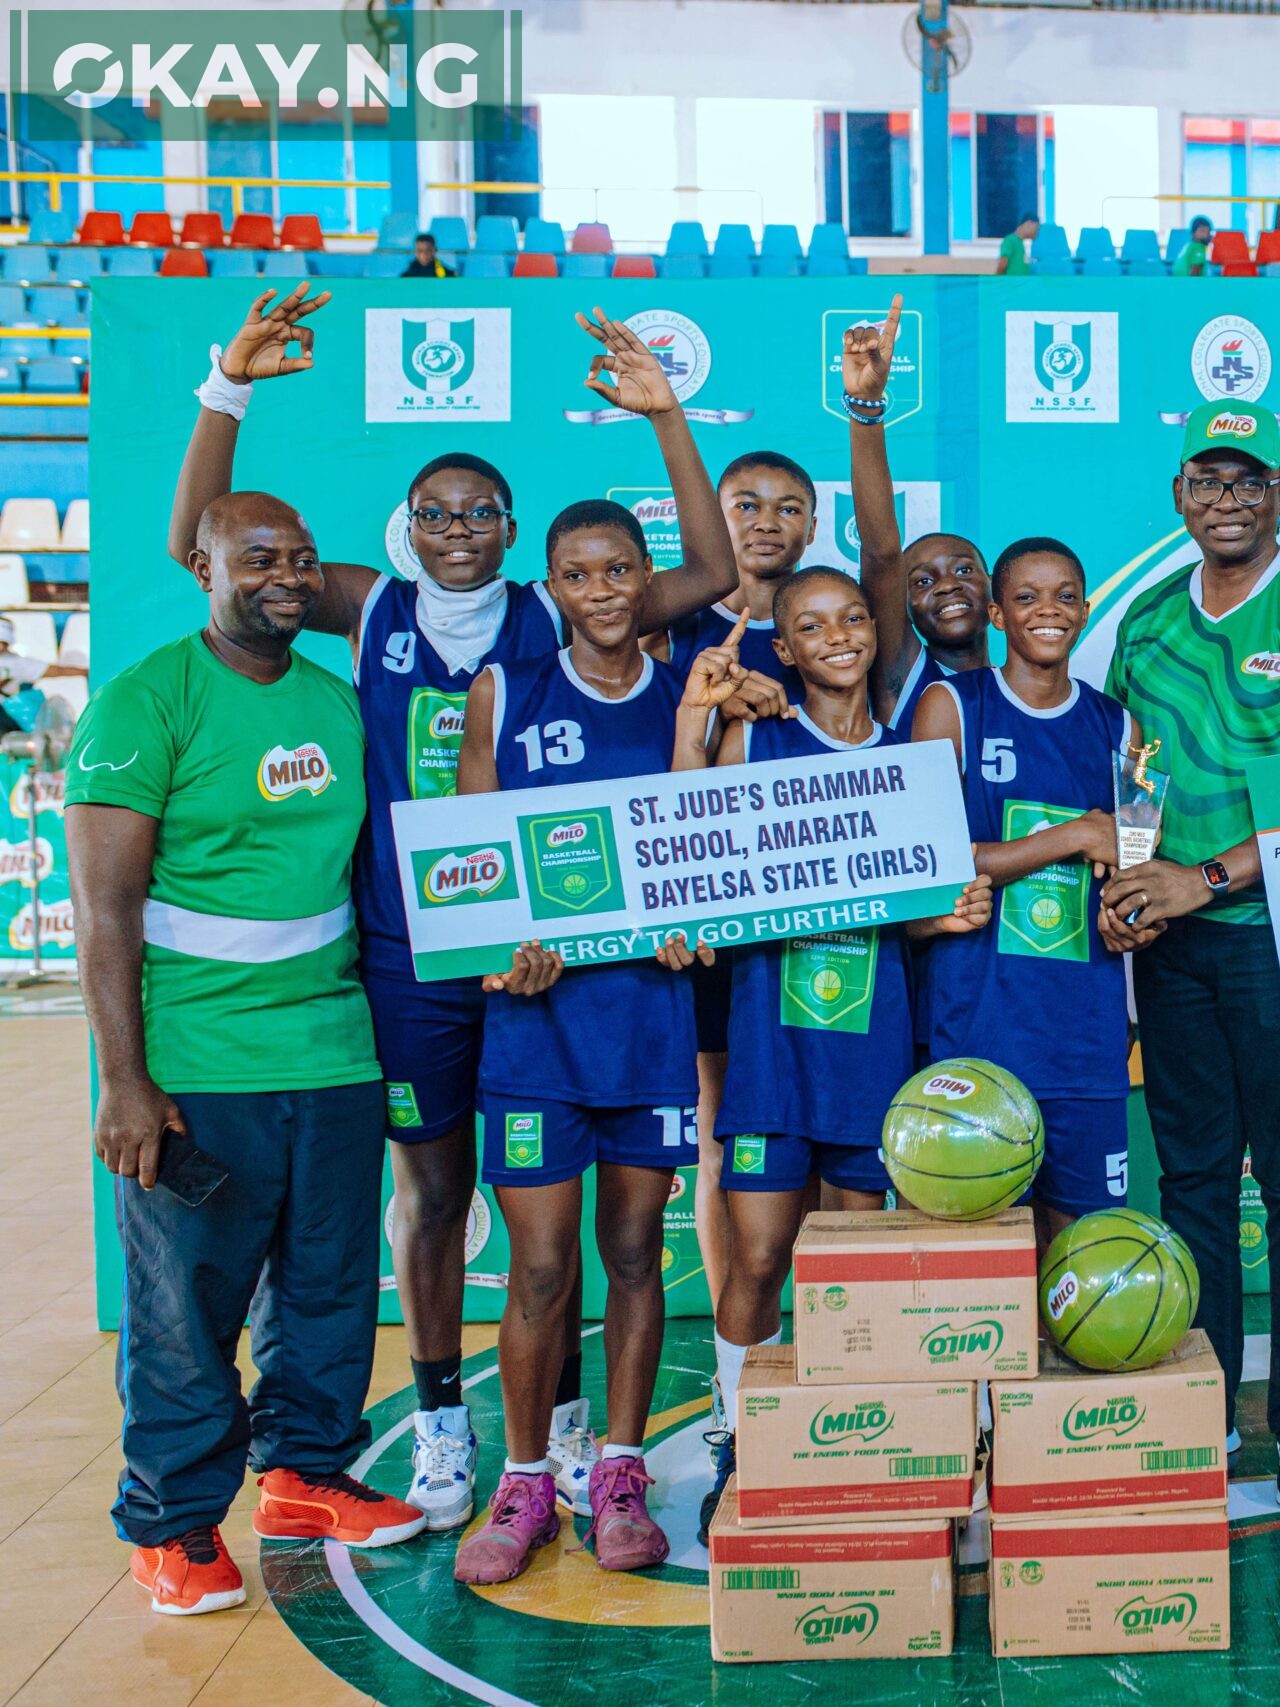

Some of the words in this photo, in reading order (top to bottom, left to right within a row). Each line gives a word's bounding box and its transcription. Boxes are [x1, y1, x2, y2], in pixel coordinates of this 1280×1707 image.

[1213, 419, 1252, 433] MILO
[381, 630, 417, 675] 9
[422, 747, 460, 758] BASKE
[515, 719, 585, 773] 13
[418, 758, 459, 769] CHAMPI
[981, 737, 1017, 784] 5
[267, 756, 325, 788] MILO
[628, 795, 667, 827] ST.
[674, 783, 765, 823] JUDE’S
[772, 763, 907, 809] GRAMMAR
[552, 828, 584, 843] MILO
[635, 828, 749, 869] SCHOOL,
[757, 810, 878, 853] AMARATA
[465, 850, 496, 866] Nestlé
[540, 854, 602, 868] CHAMPIONSHIP
[542, 848, 598, 860] BASKETBALL
[436, 861, 499, 891] MILO
[641, 869, 756, 911] BAYELSA
[764, 857, 839, 895] STATE
[847, 843, 938, 888] (GIRLS)
[646, 927, 689, 950] TO
[698, 919, 744, 945] GO
[752, 900, 890, 937] FURTHER
[792, 941, 868, 956] CHAMPIONSHIP
[929, 1078, 972, 1095] MILO
[1105, 1150, 1128, 1197] 5
[1050, 1280, 1076, 1317] MILO
[900, 1307, 932, 1315] DRINK
[933, 1305, 961, 1314] FOOD
[962, 1304, 1001, 1313] ENERGY
[1003, 1303, 1021, 1312] THE
[927, 1330, 992, 1357] MILO
[821, 1409, 886, 1435] MILO
[1074, 1403, 1138, 1431] MILO
[792, 1452, 811, 1460] THE
[813, 1451, 851, 1459] ENERGY
[853, 1449, 880, 1457] FOOD
[882, 1447, 913, 1456] DRINK
[1046, 1448, 1064, 1456] THE
[1066, 1445, 1104, 1455] ENERGY
[1106, 1443, 1132, 1451] FOOD
[1133, 1440, 1165, 1449] DRINK
[1096, 1580, 1126, 1588] DRINK
[1127, 1579, 1154, 1587] FOOD
[1157, 1577, 1194, 1586] ENERGY
[1196, 1576, 1214, 1584] THE
[808, 1591, 836, 1599] FOOD
[837, 1590, 877, 1598] ENERGY
[878, 1589, 896, 1597] THE
[1122, 1603, 1186, 1628] MILO
[802, 1612, 868, 1638] MILO
